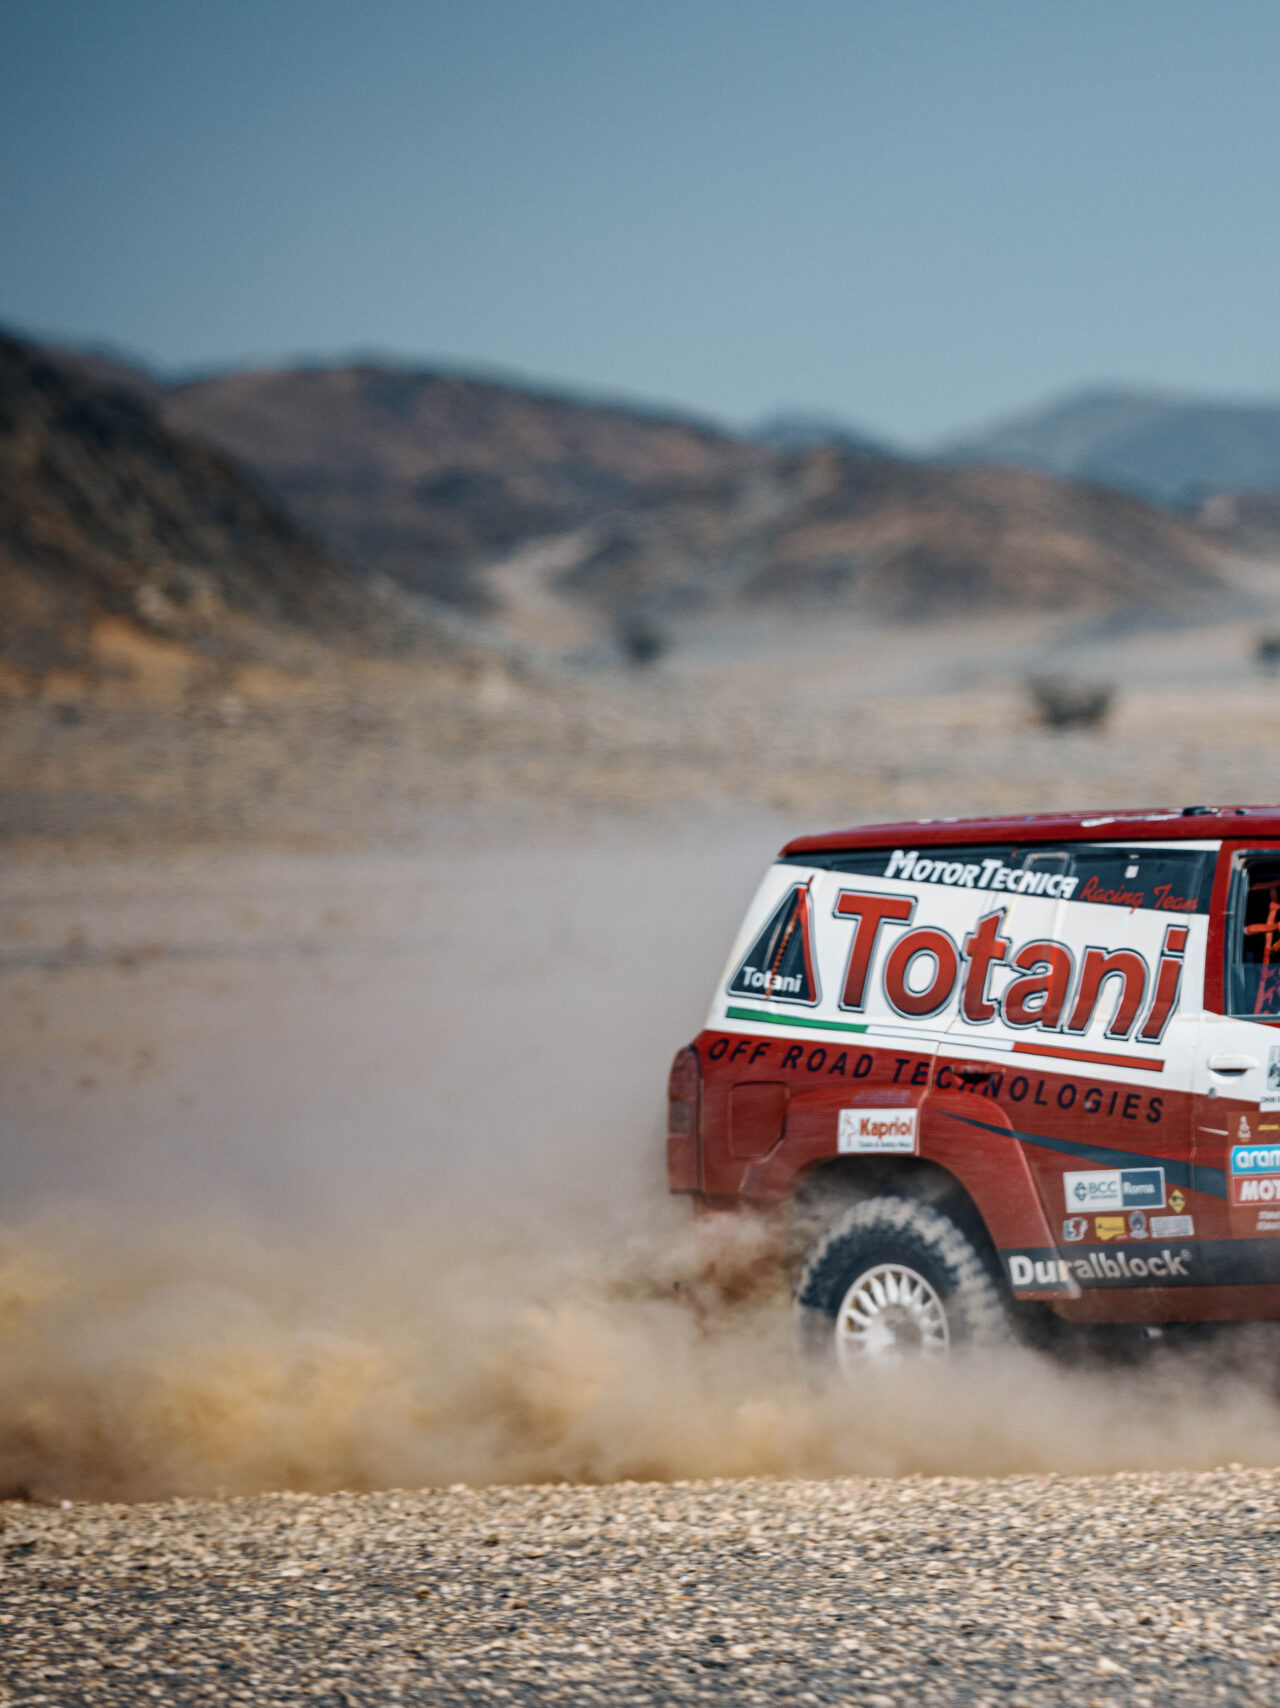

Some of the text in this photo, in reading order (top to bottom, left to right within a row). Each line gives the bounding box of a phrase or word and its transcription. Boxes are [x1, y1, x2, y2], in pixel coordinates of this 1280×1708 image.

[1080, 876, 1144, 914] Racing
[1153, 884, 1198, 912] Team
[742, 966, 803, 993] Totani
[832, 887, 1191, 1045] Totani
[708, 1038, 772, 1065] OFF
[781, 1045, 874, 1079] ROAD
[859, 1116, 913, 1140] Kapriol
[1089, 1181, 1155, 1195] BCC Roma
[1008, 1249, 1189, 1286] Duralblock
